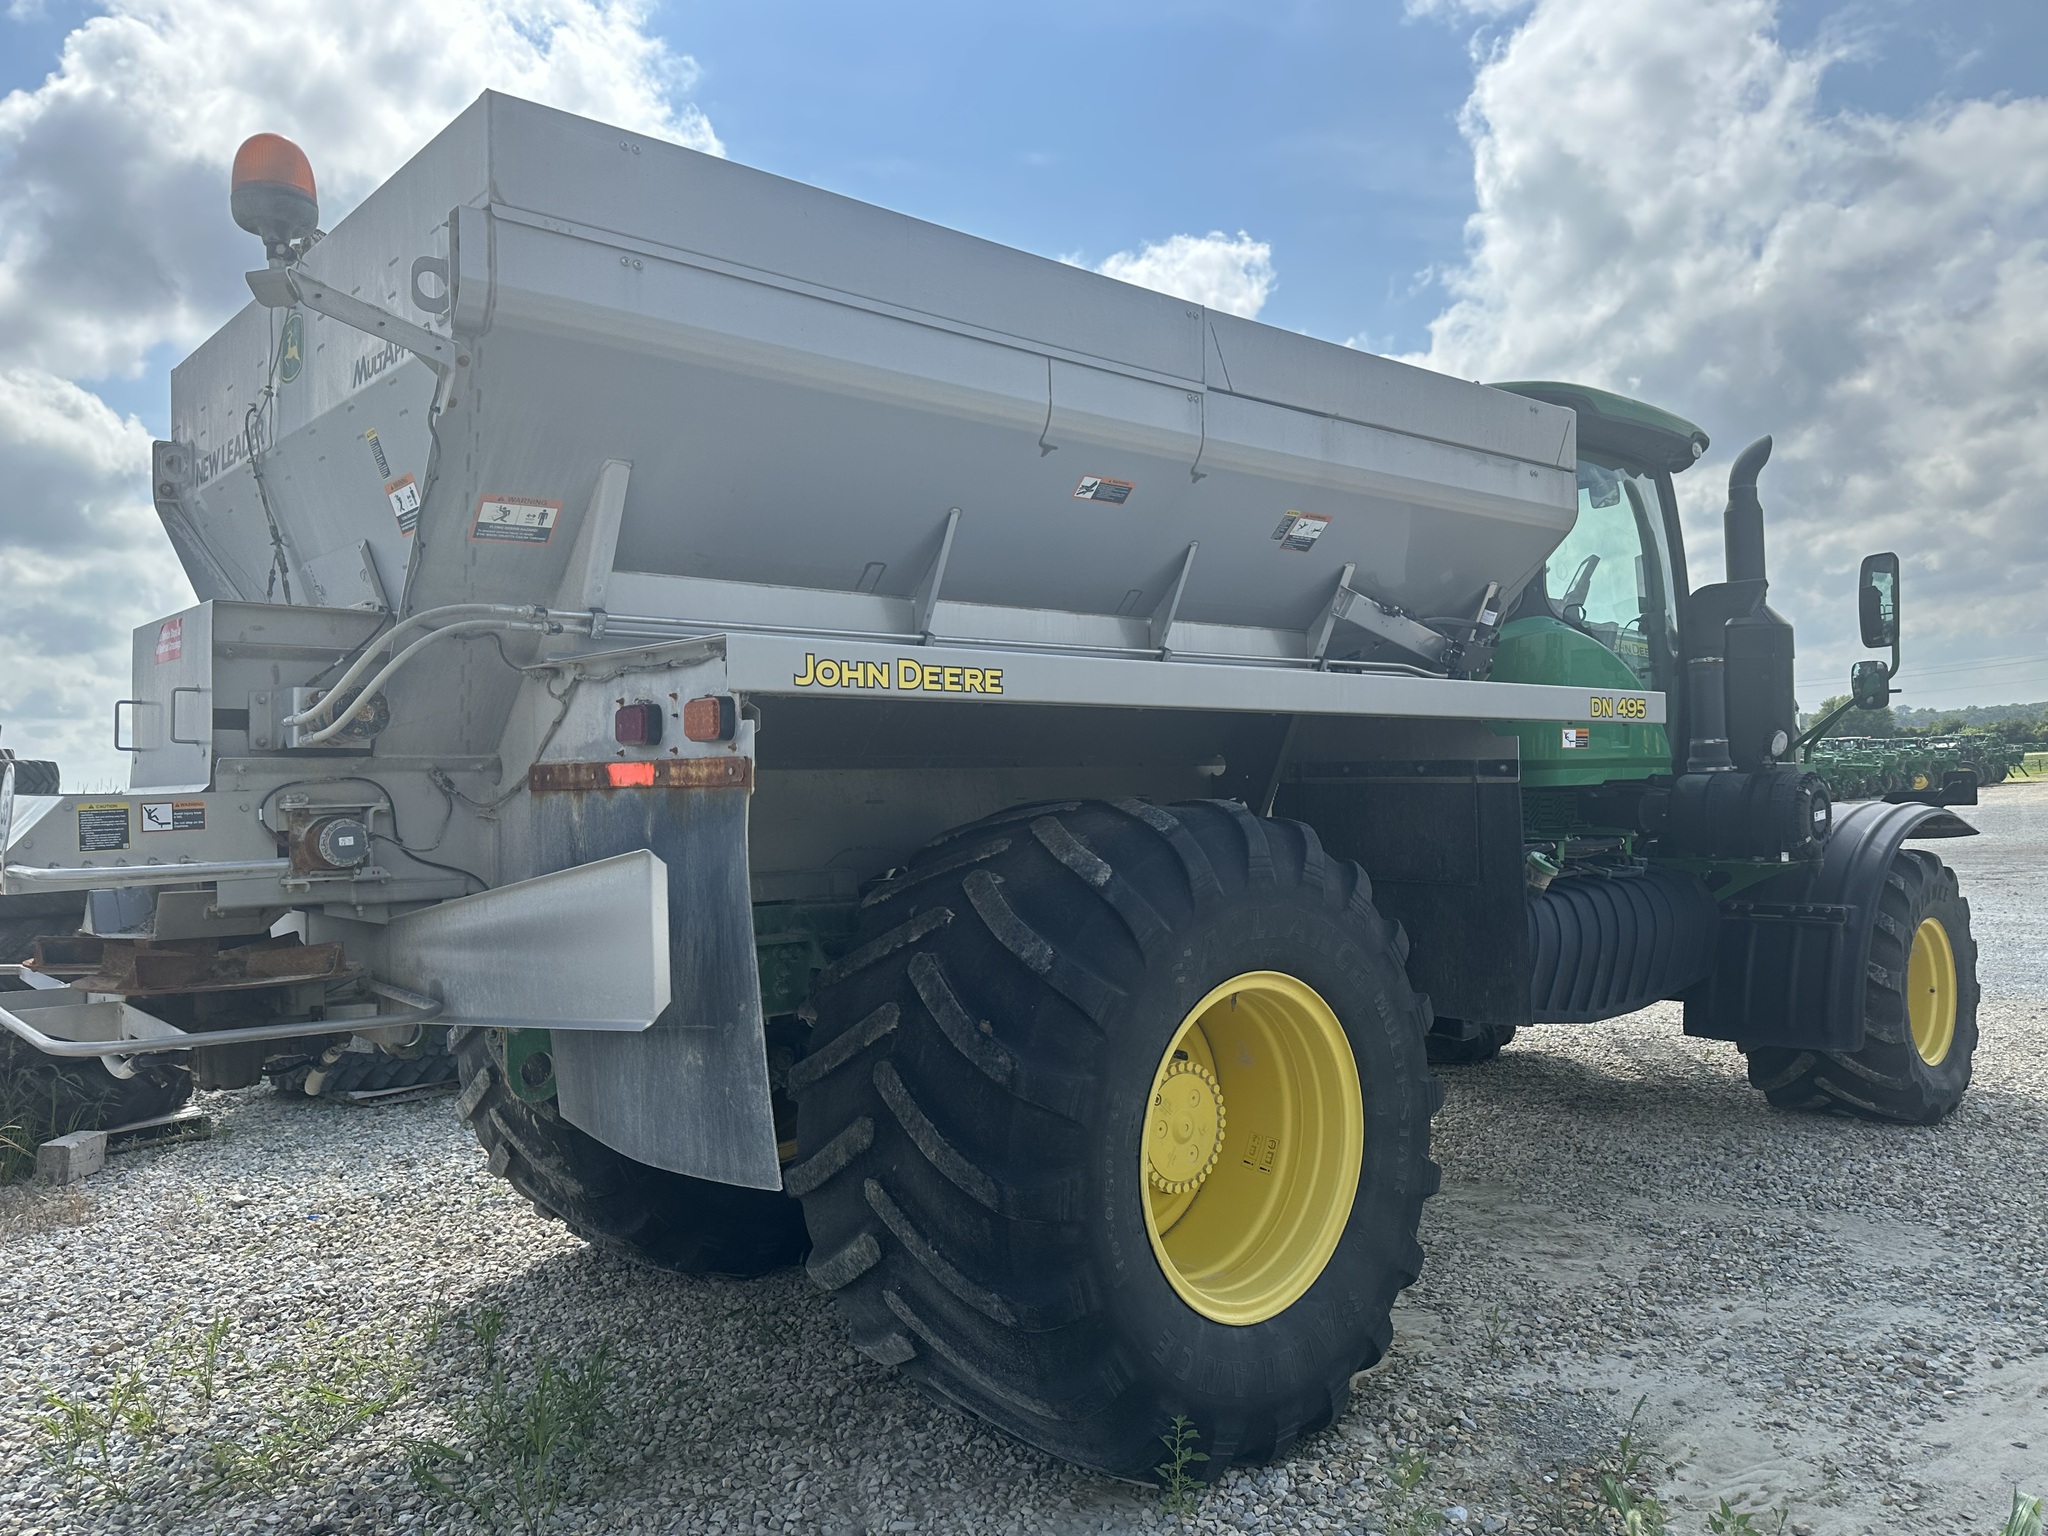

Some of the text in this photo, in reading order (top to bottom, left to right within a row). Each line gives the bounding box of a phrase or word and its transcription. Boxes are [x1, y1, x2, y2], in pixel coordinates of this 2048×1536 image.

[195, 447, 221, 488] NEW
[508, 496, 548, 506] WARNING
[794, 652, 1003, 694] JOHN DEERE
[1590, 696, 1647, 719] DN 495
